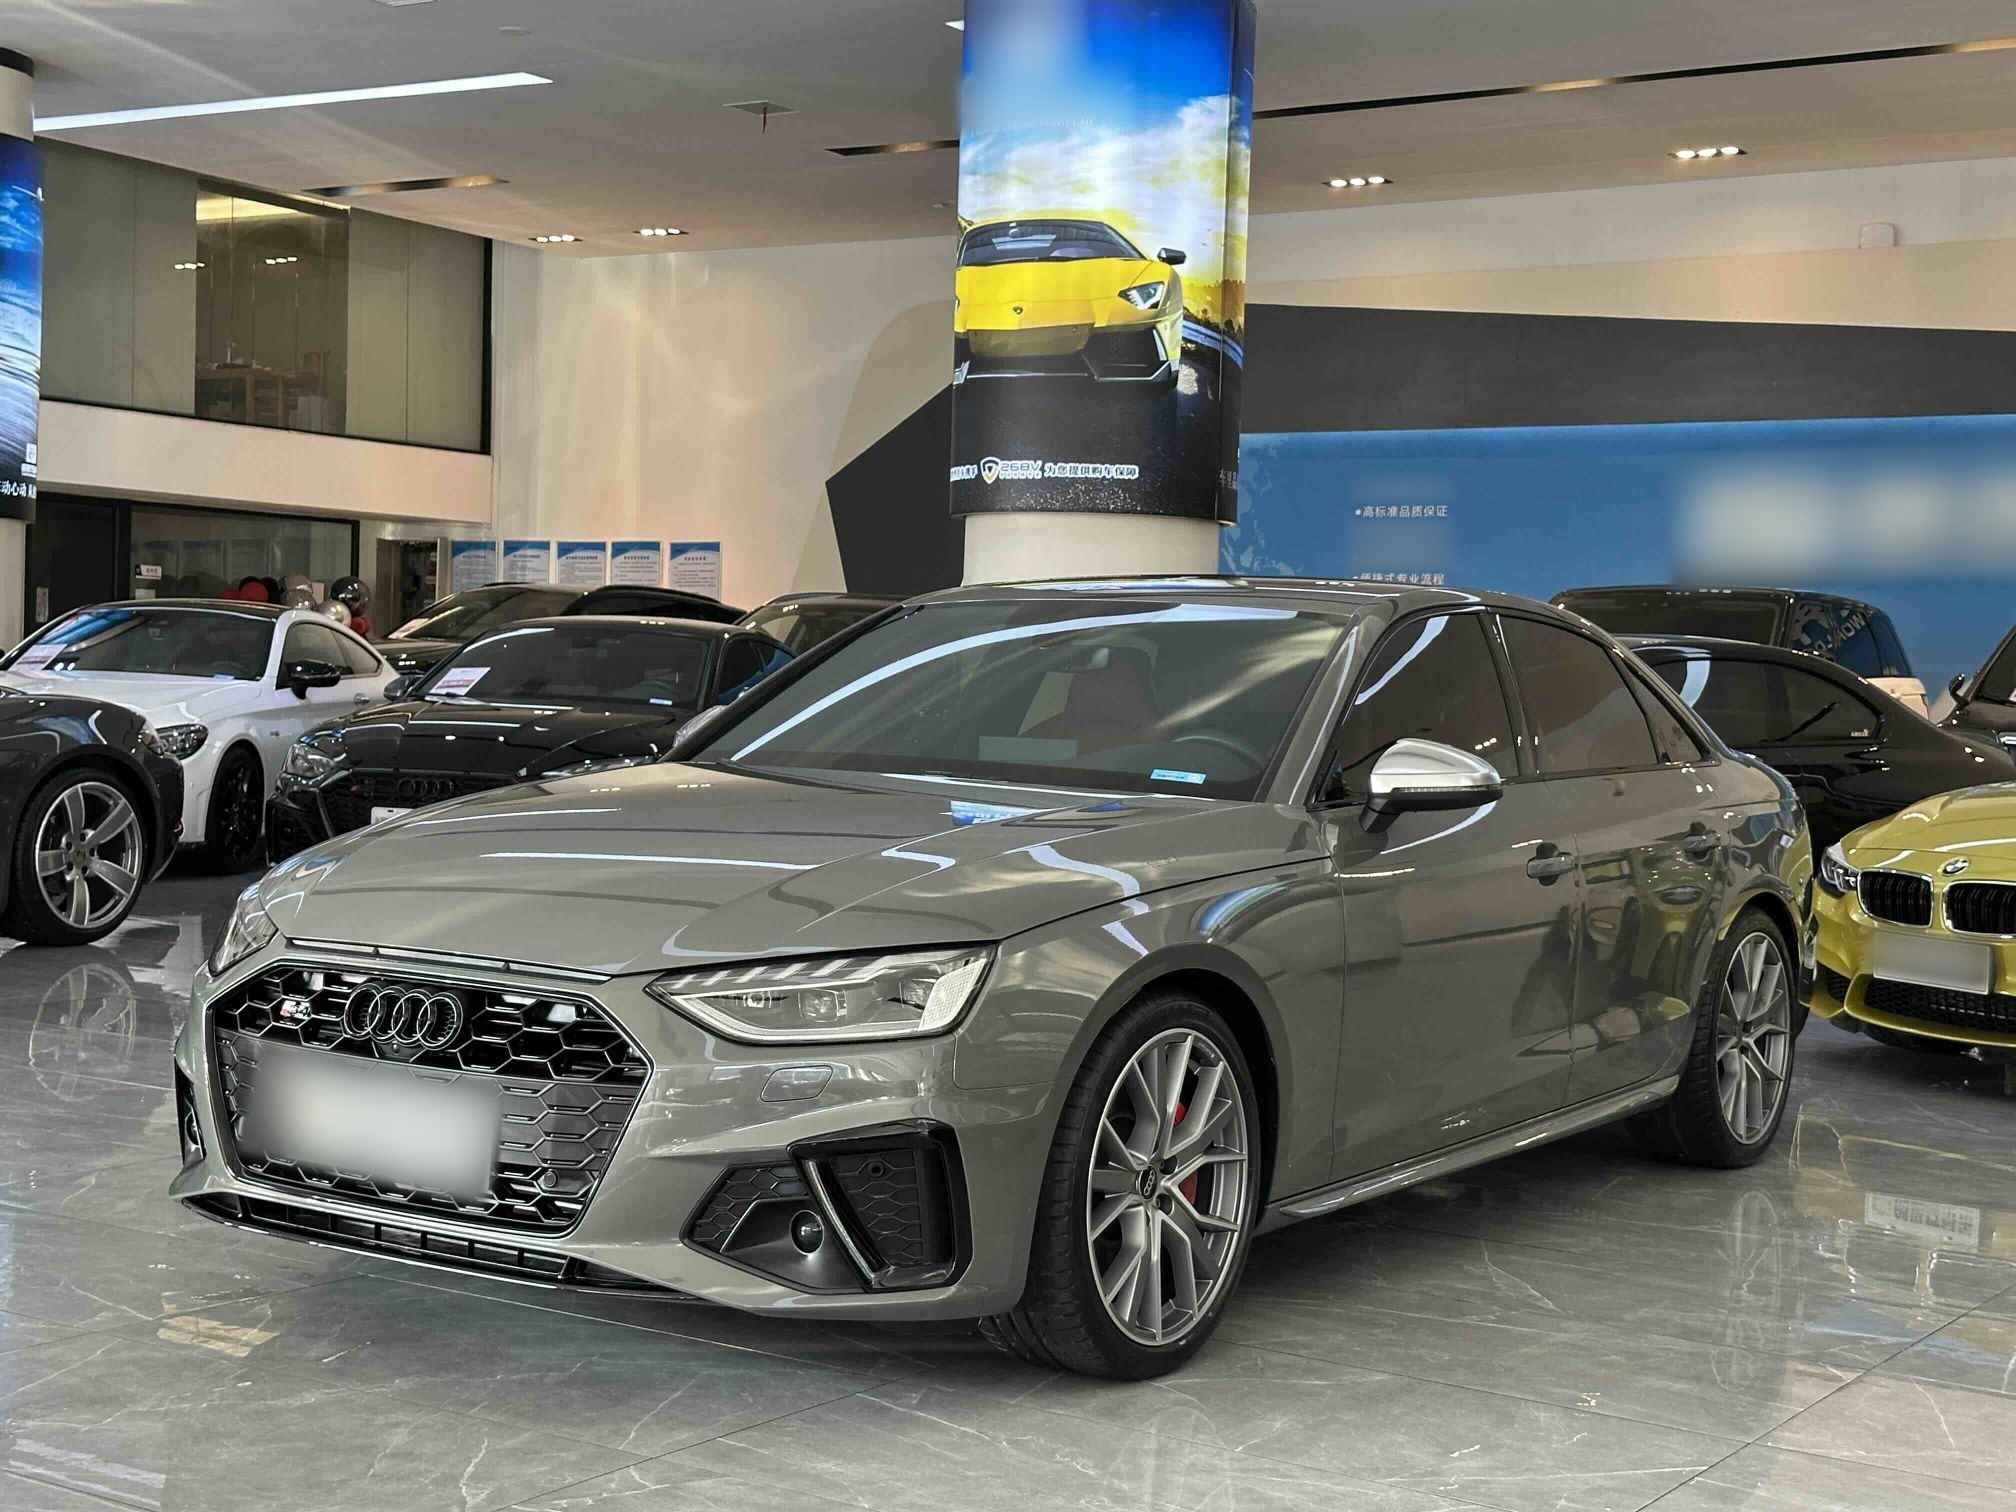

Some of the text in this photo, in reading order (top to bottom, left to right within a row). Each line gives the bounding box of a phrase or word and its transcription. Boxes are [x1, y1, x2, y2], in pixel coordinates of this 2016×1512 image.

[1045, 464, 1136, 478] 为您提供购车保障
[1362, 505, 1448, 518] 高标准品质保证
